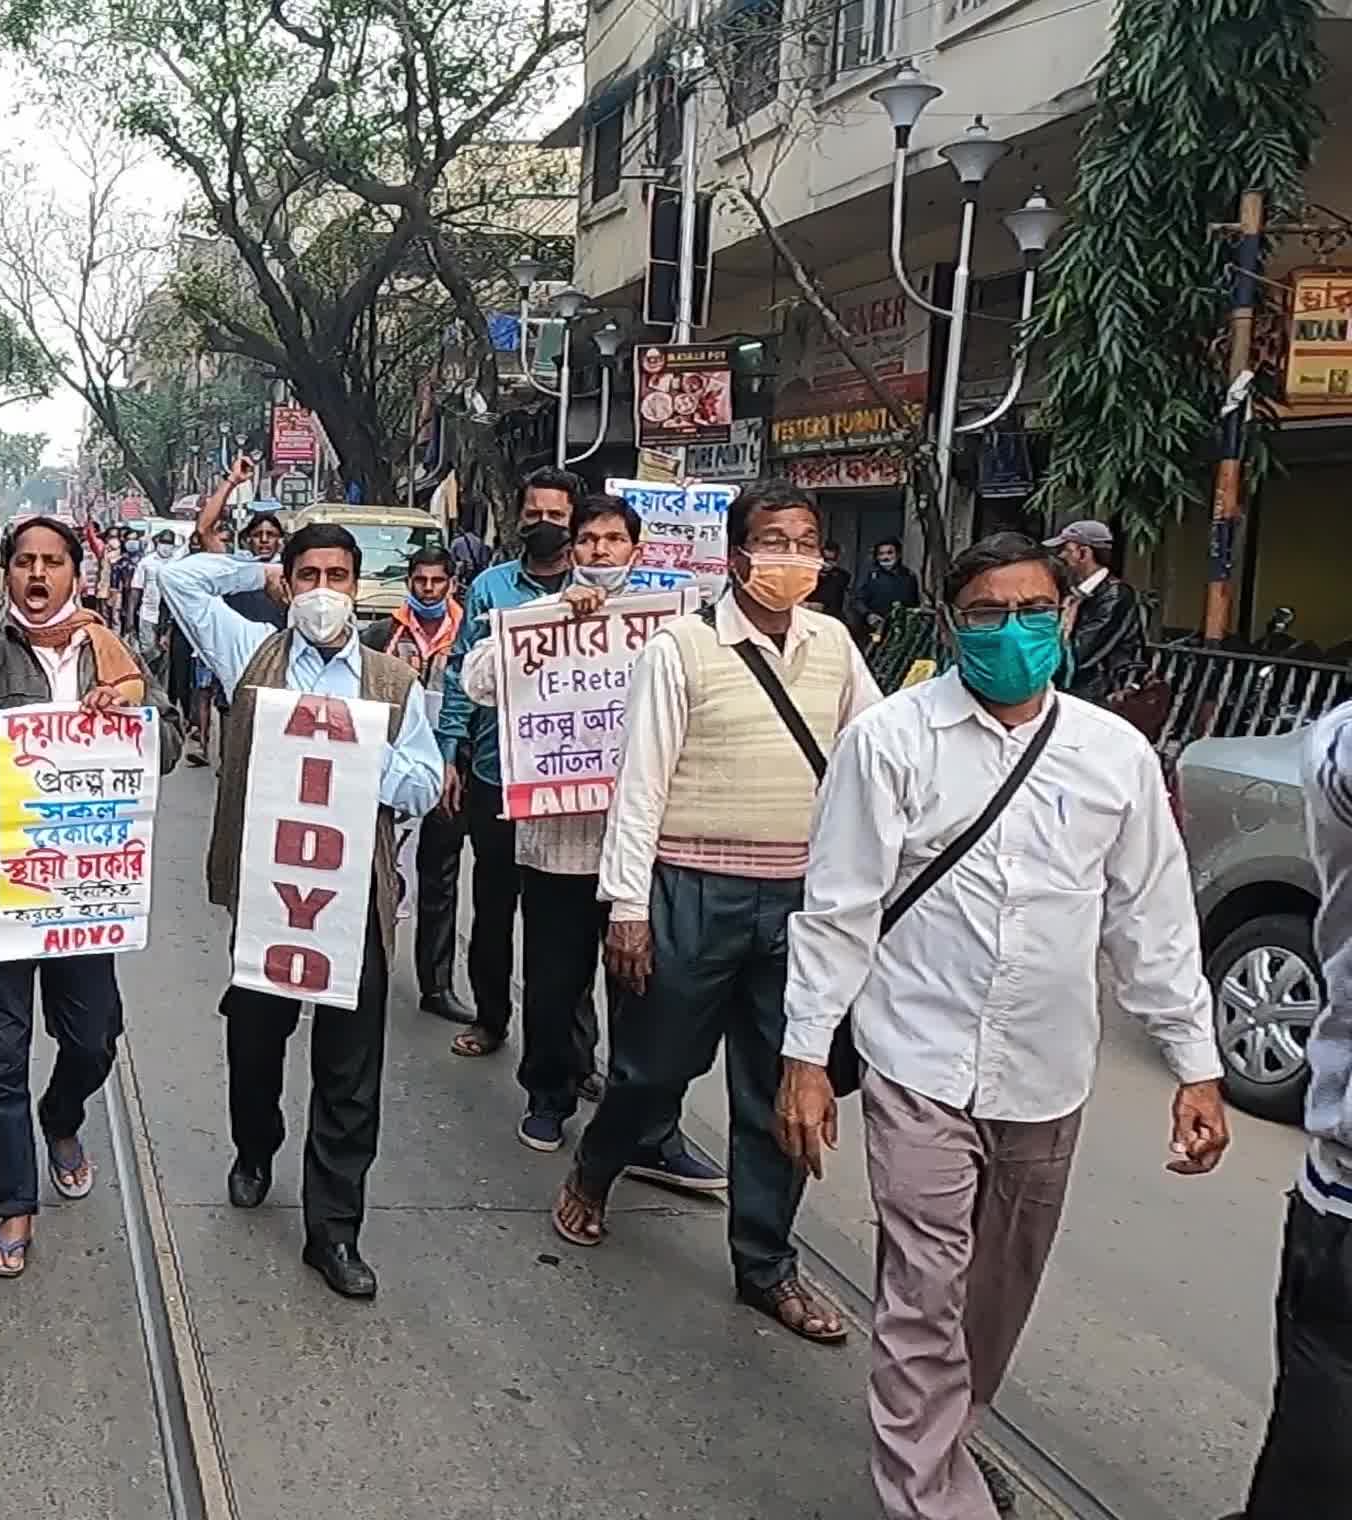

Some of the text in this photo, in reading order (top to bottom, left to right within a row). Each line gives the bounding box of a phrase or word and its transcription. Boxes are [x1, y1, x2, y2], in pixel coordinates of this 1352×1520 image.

[34, 768, 145, 798] প্রকল্প নয়
[24, 799, 139, 821] সকল
[530, 783, 617, 816] AID
[263, 694, 359, 991] AIDYO
[76, 839, 147, 881] চাকরি
[44, 923, 126, 953] AIDYO
